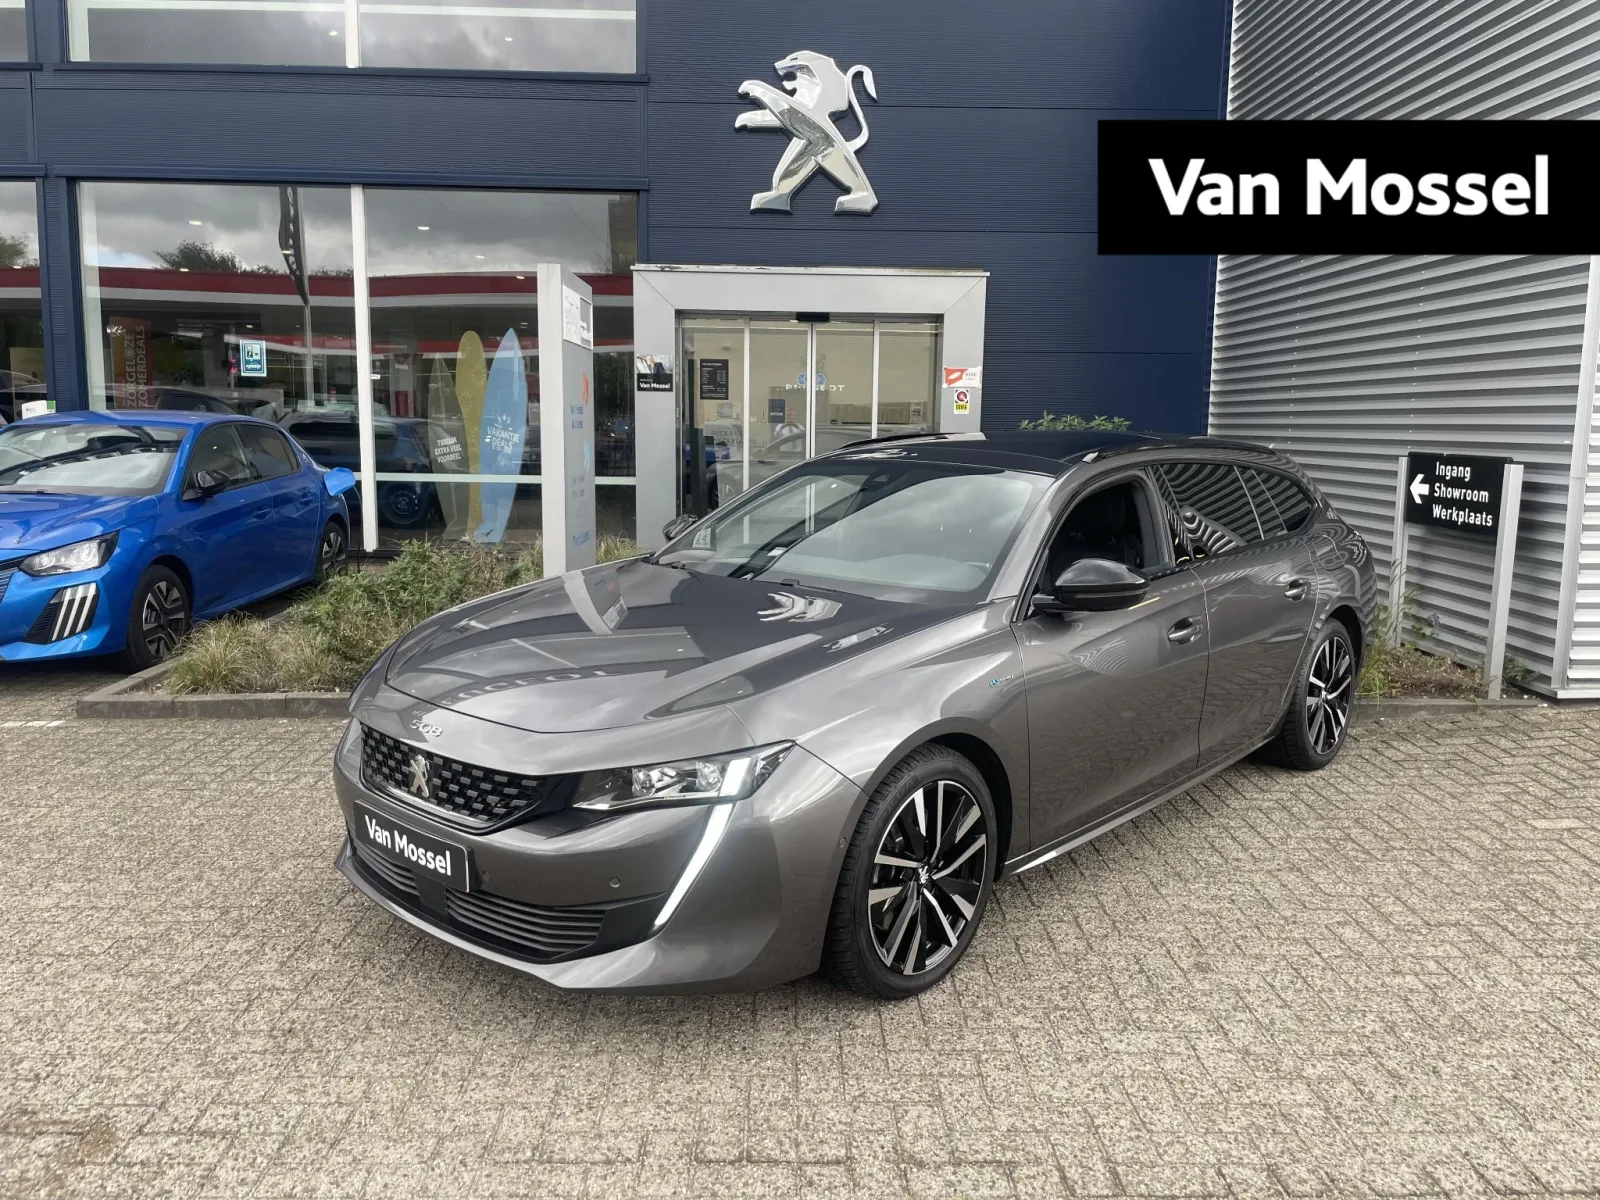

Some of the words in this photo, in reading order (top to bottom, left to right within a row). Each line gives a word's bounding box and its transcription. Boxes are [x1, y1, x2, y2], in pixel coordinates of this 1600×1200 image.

[487, 426, 520, 443] VAKANTIE
[491, 437, 513, 450] DEALS
[434, 446, 450, 456] EXTRA
[1435, 461, 1471, 482] Ingang
[1433, 482, 1489, 503] Showroom
[1432, 503, 1493, 527] Werkplaats
[409, 719, 443, 738] 508
[364, 814, 392, 849] Van
[394, 829, 452, 876] Mossel
